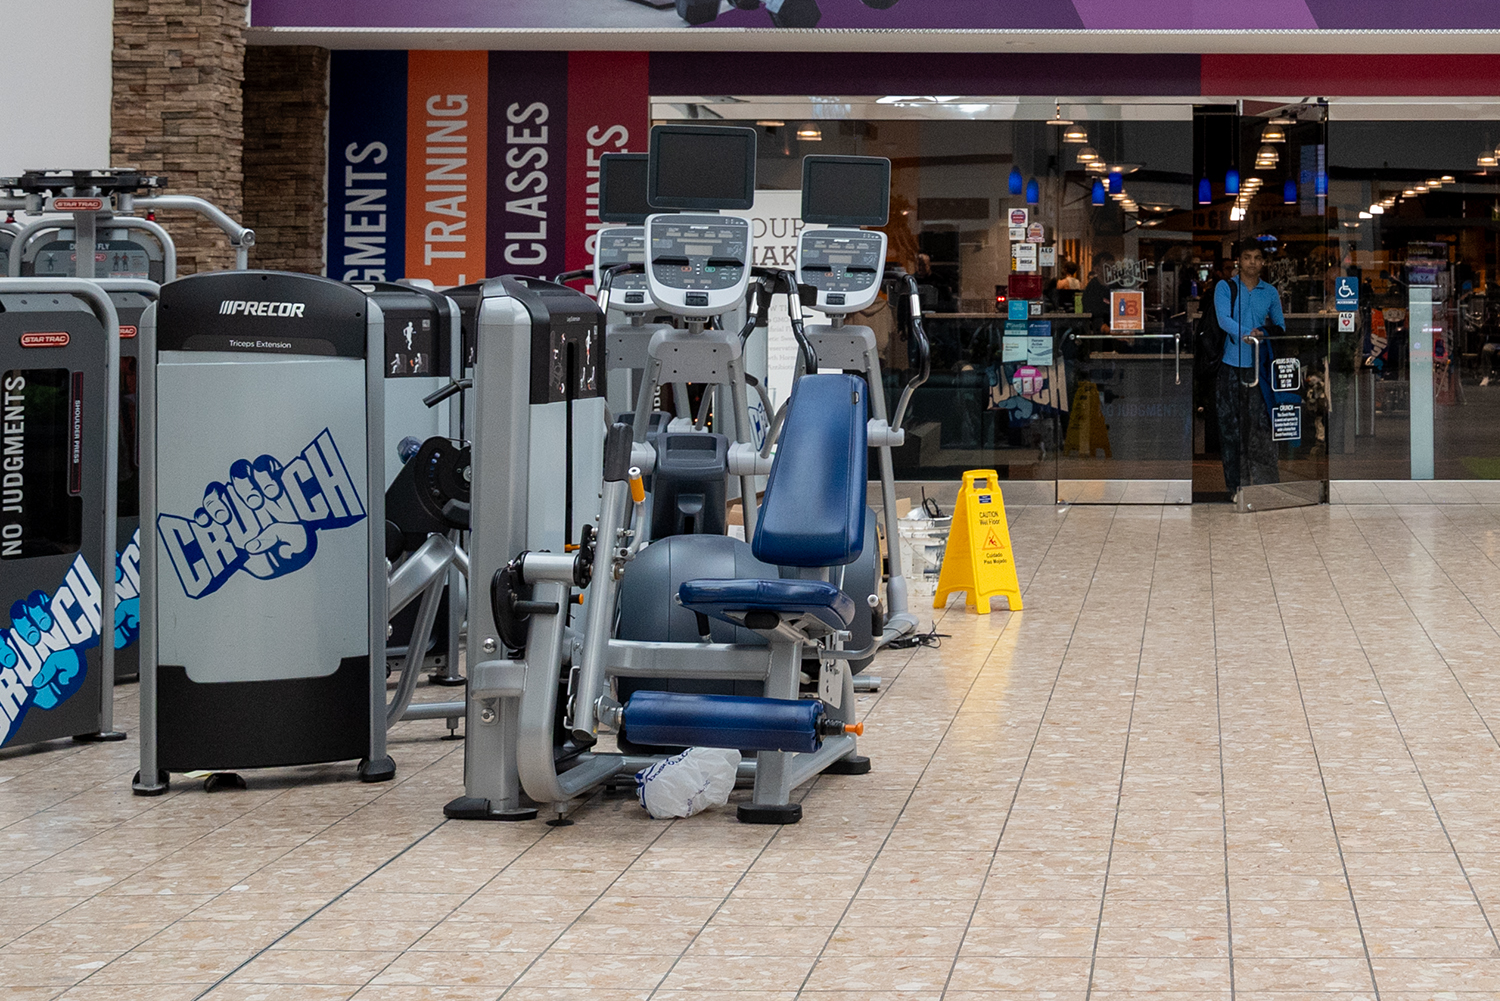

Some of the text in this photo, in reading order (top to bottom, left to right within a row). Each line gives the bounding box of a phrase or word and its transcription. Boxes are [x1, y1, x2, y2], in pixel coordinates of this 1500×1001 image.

[343, 141, 389, 284] GMENTS
[424, 94, 469, 266] TRAINING
[504, 101, 549, 266] CLASSES
[229, 339, 292, 349] Triceps Extension
[231, 300, 305, 318] PRECOR
[2, 376, 26, 556] NO JUDGMENTS
[157, 427, 367, 599] CRUNCH
